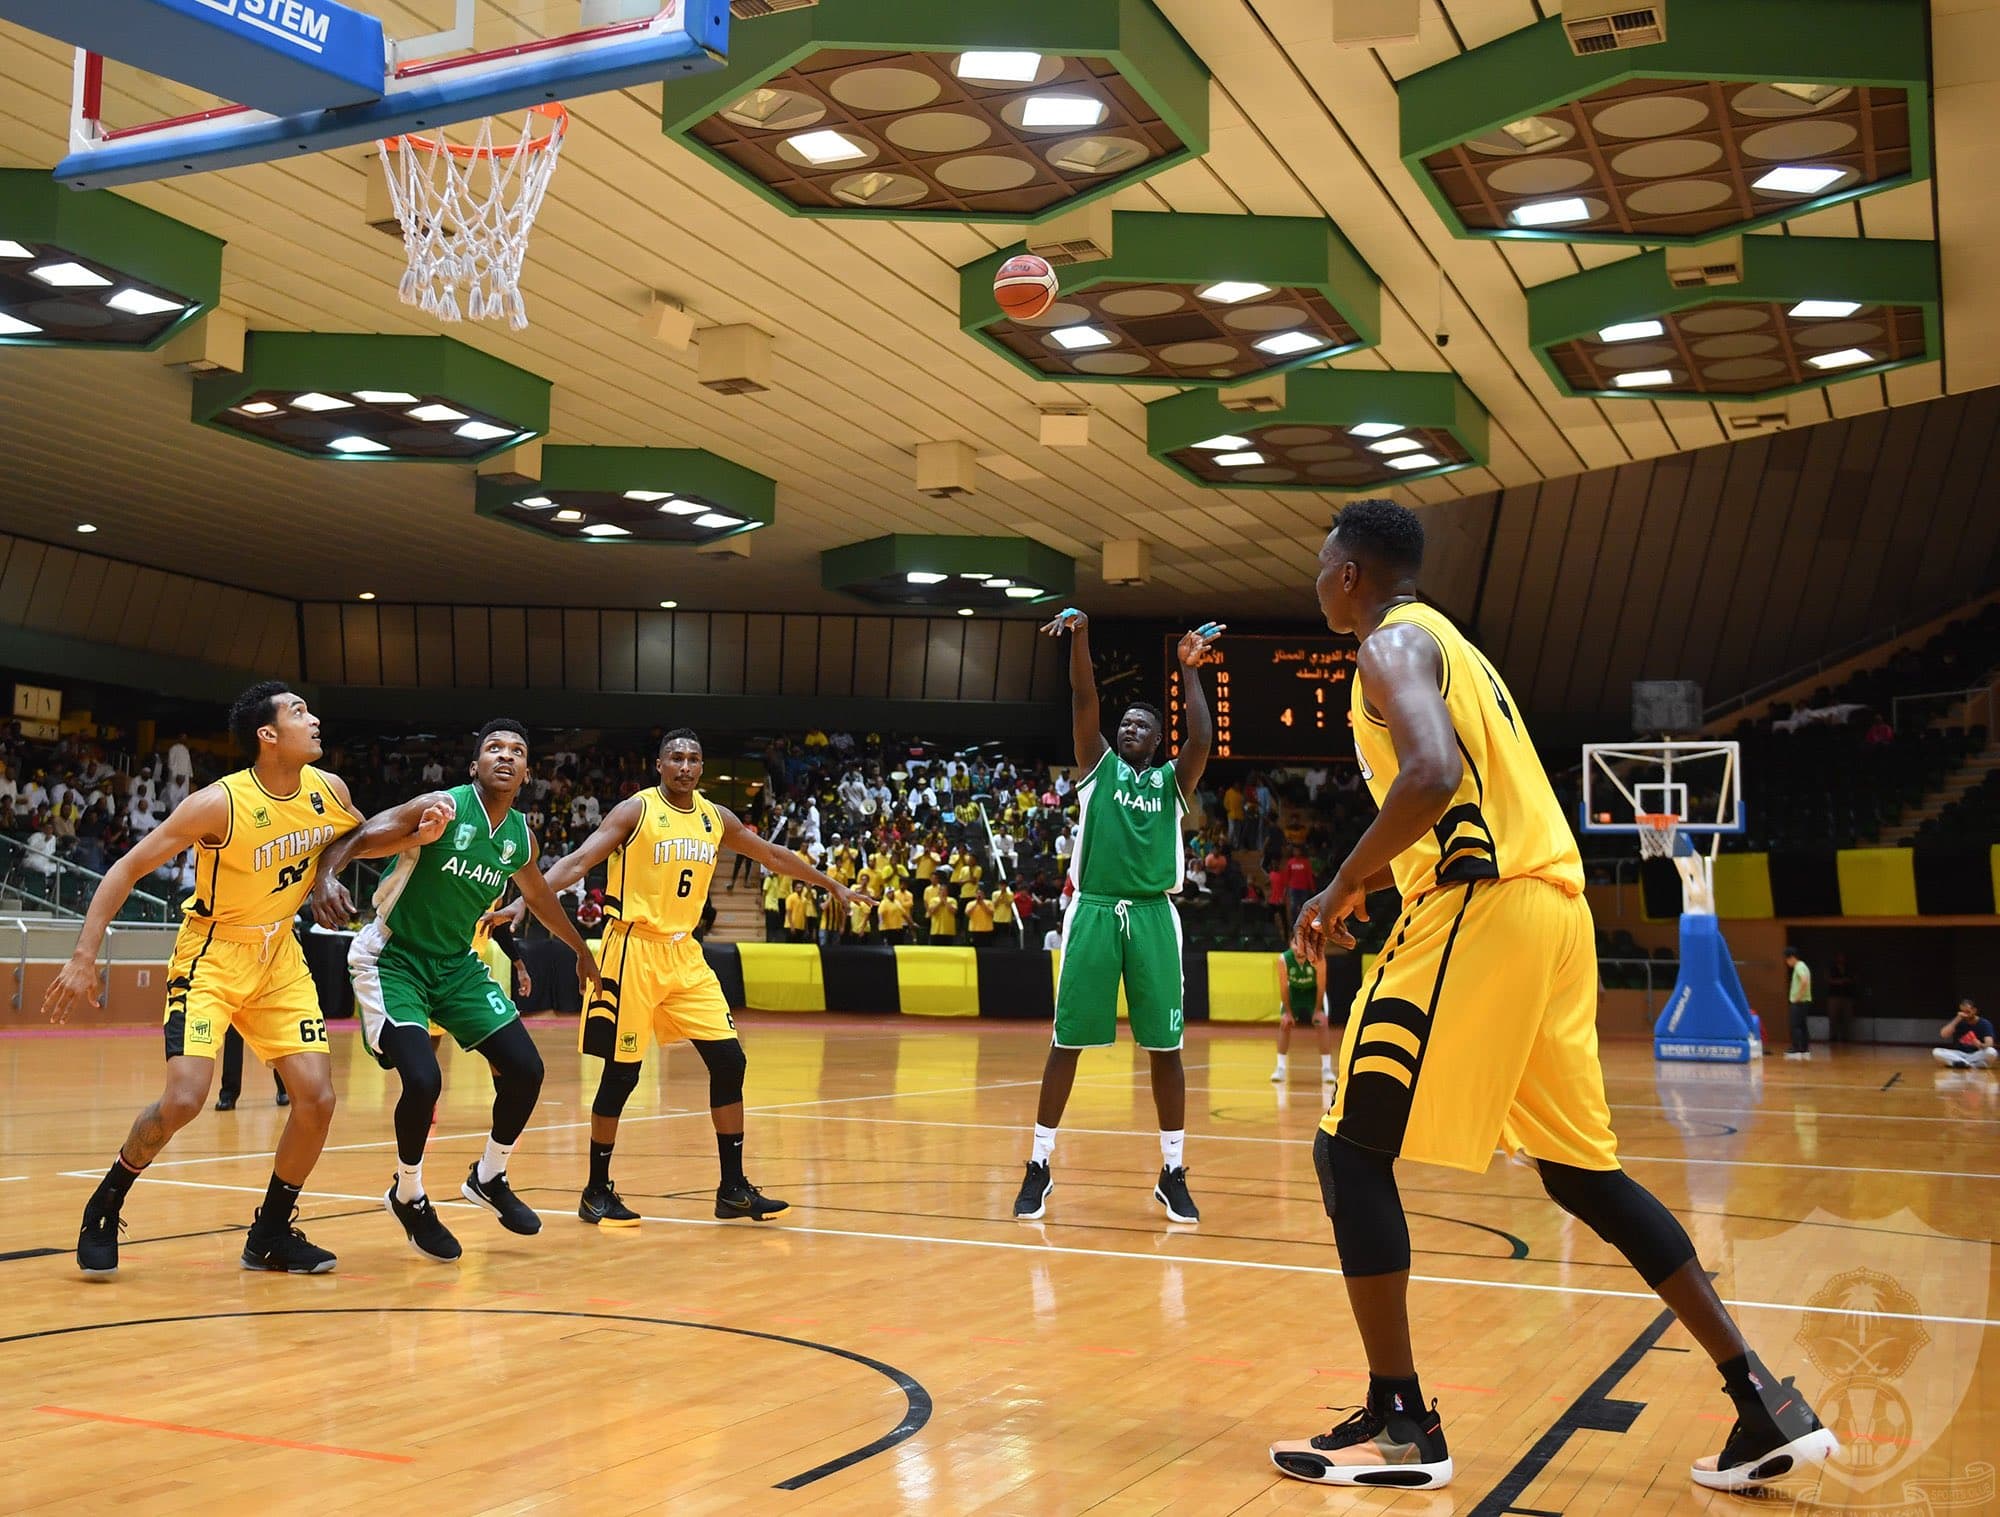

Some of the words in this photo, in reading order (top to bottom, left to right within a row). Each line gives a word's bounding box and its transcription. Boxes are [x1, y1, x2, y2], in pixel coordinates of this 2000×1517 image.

[1170, 671, 1179, 682] 4
[1217, 671, 1230, 684] 10
[1217, 686, 1230, 698] 11
[1315, 687, 1324, 704] 1
[1217, 701, 1230, 713] 12
[1170, 714, 1179, 726] 7
[1217, 716, 1230, 727] 13
[1280, 707, 1293, 727] 4
[1170, 729, 1179, 741] 8
[1217, 730, 1230, 742] 14
[455, 822, 477, 851] 5
[253, 824, 336, 873] ITTIHAD
[441, 856, 503, 887] Al-Ahli
[677, 868, 693, 898] 6
[486, 990, 507, 1015] 5
[1170, 1008, 1181, 1032] 12
[299, 1018, 327, 1043] 62
